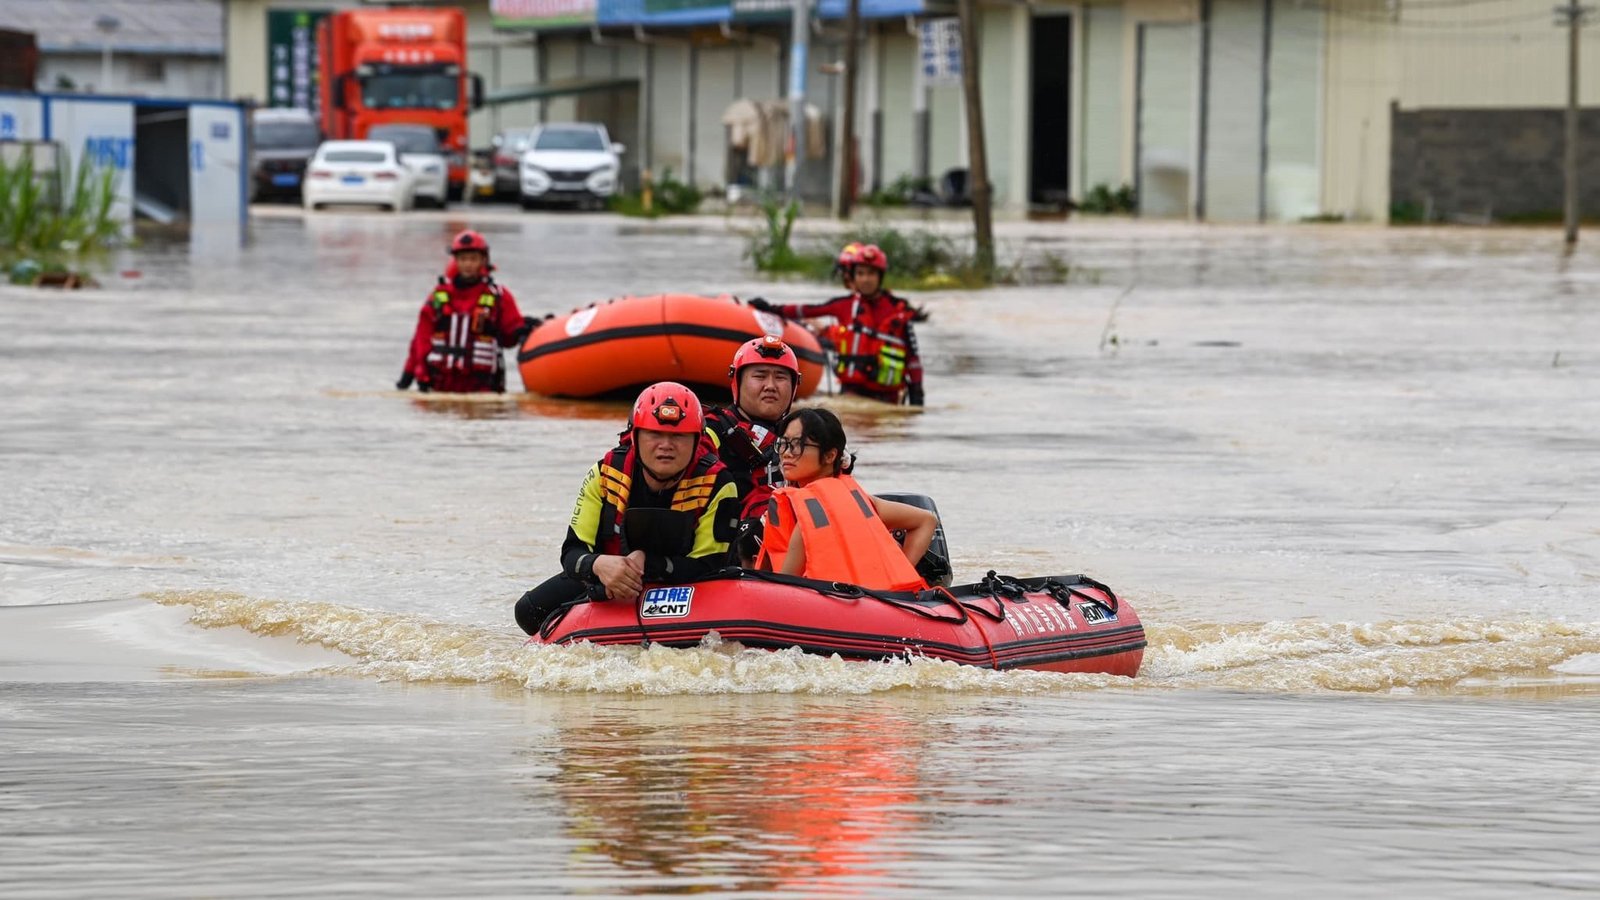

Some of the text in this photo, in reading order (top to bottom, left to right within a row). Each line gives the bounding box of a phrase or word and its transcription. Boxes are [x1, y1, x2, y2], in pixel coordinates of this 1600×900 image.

[571, 469, 595, 525] RESCUE
[646, 587, 691, 603] 中艇
[659, 604, 686, 614] CNT
